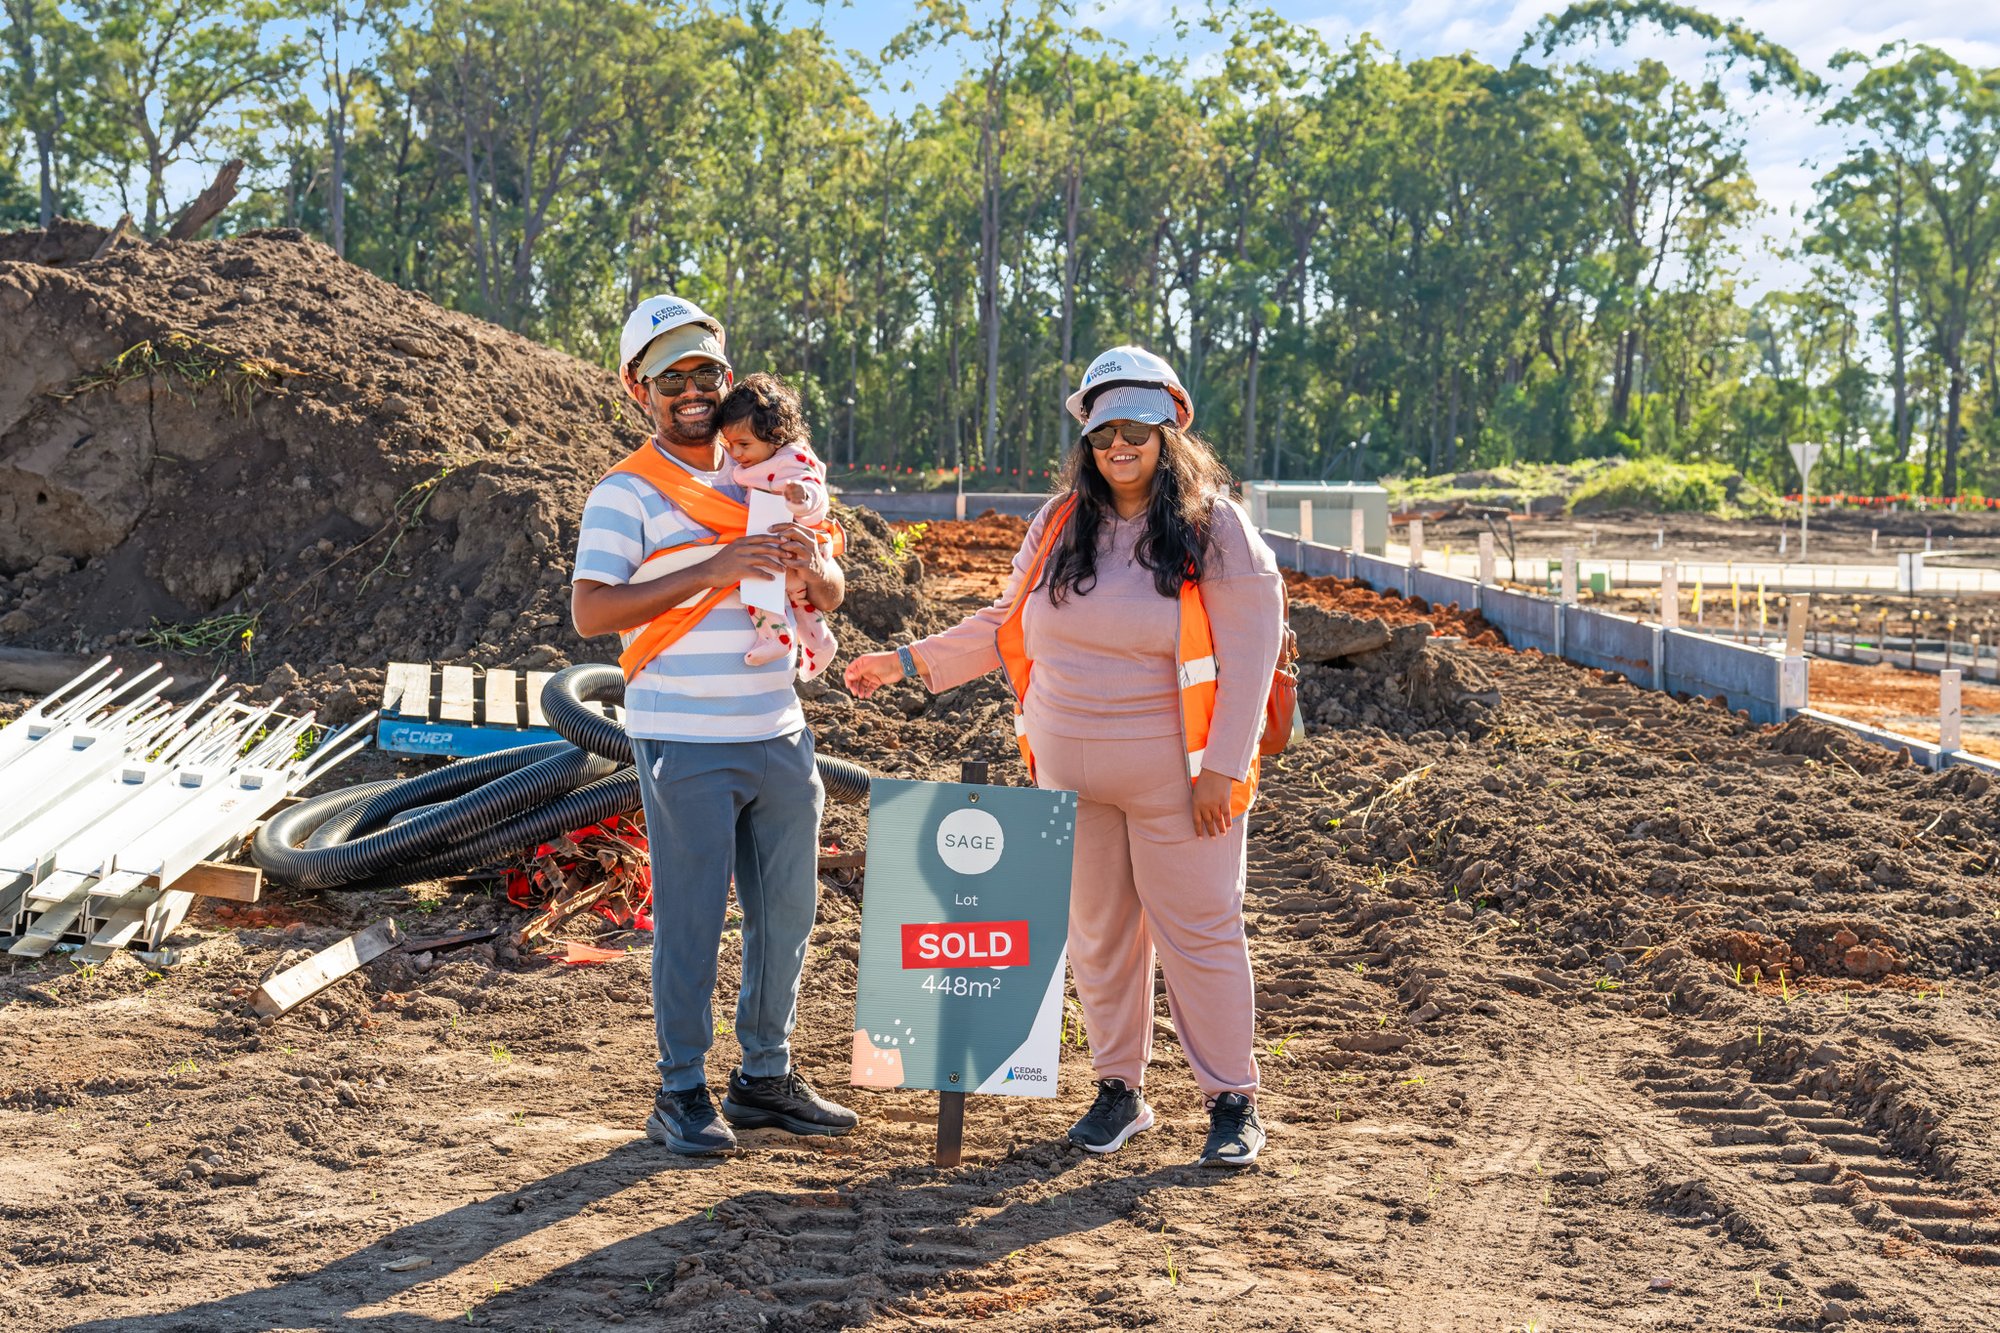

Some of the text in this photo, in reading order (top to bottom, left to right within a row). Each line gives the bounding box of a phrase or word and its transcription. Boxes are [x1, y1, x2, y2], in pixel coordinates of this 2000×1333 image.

[408, 730, 453, 744] CHEP
[945, 834, 995, 850] SAGE
[955, 894, 978, 906] Lot
[918, 931, 1012, 960] SOLD
[1013, 1066, 1042, 1074] CEDAR
